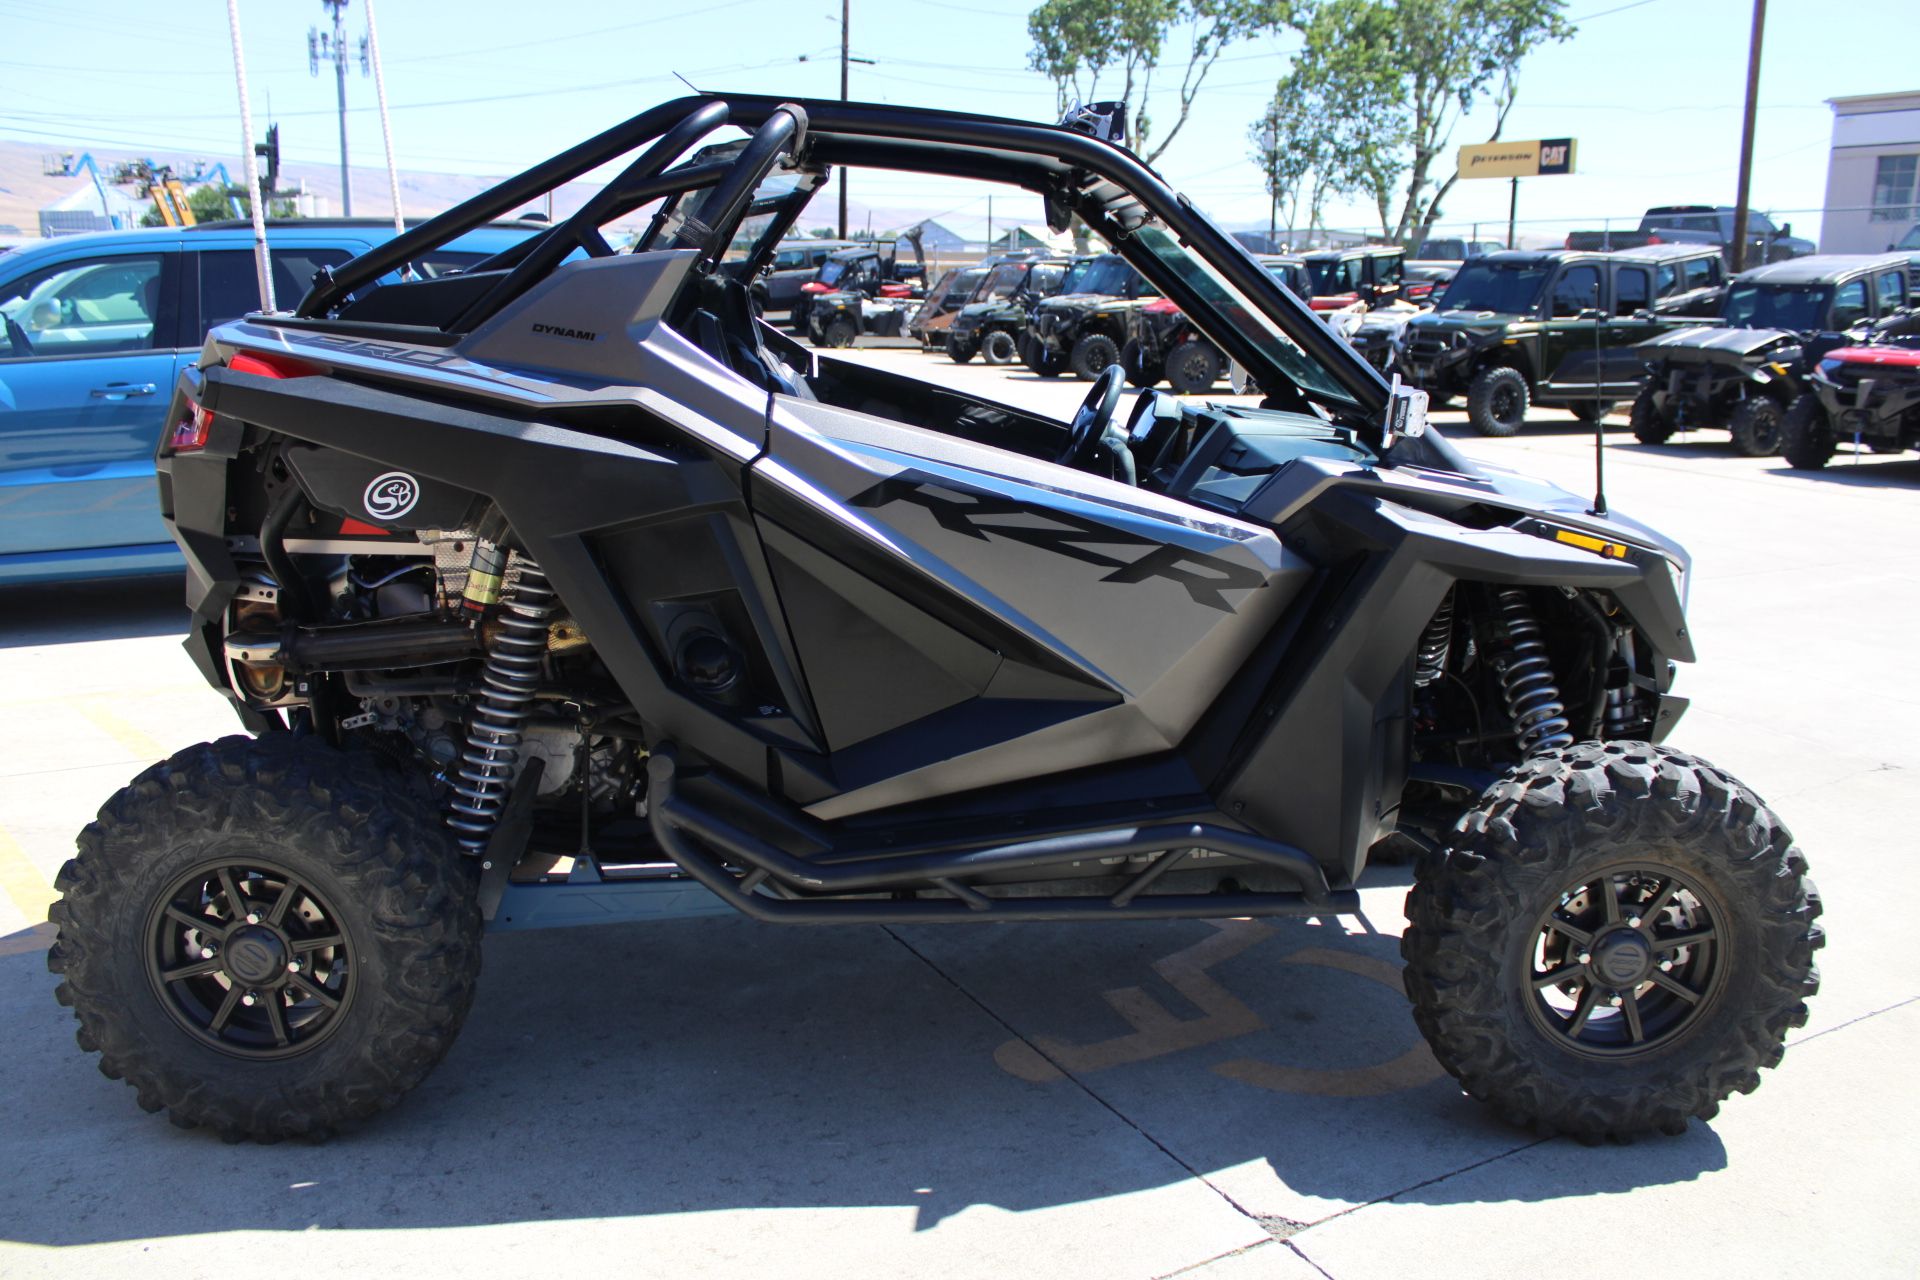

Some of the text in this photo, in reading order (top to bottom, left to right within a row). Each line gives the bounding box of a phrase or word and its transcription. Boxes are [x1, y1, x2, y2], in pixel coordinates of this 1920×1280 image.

[1540, 146, 1568, 167] CAT
[532, 322, 608, 343] DYNAMI
[845, 467, 1270, 615] RZR
